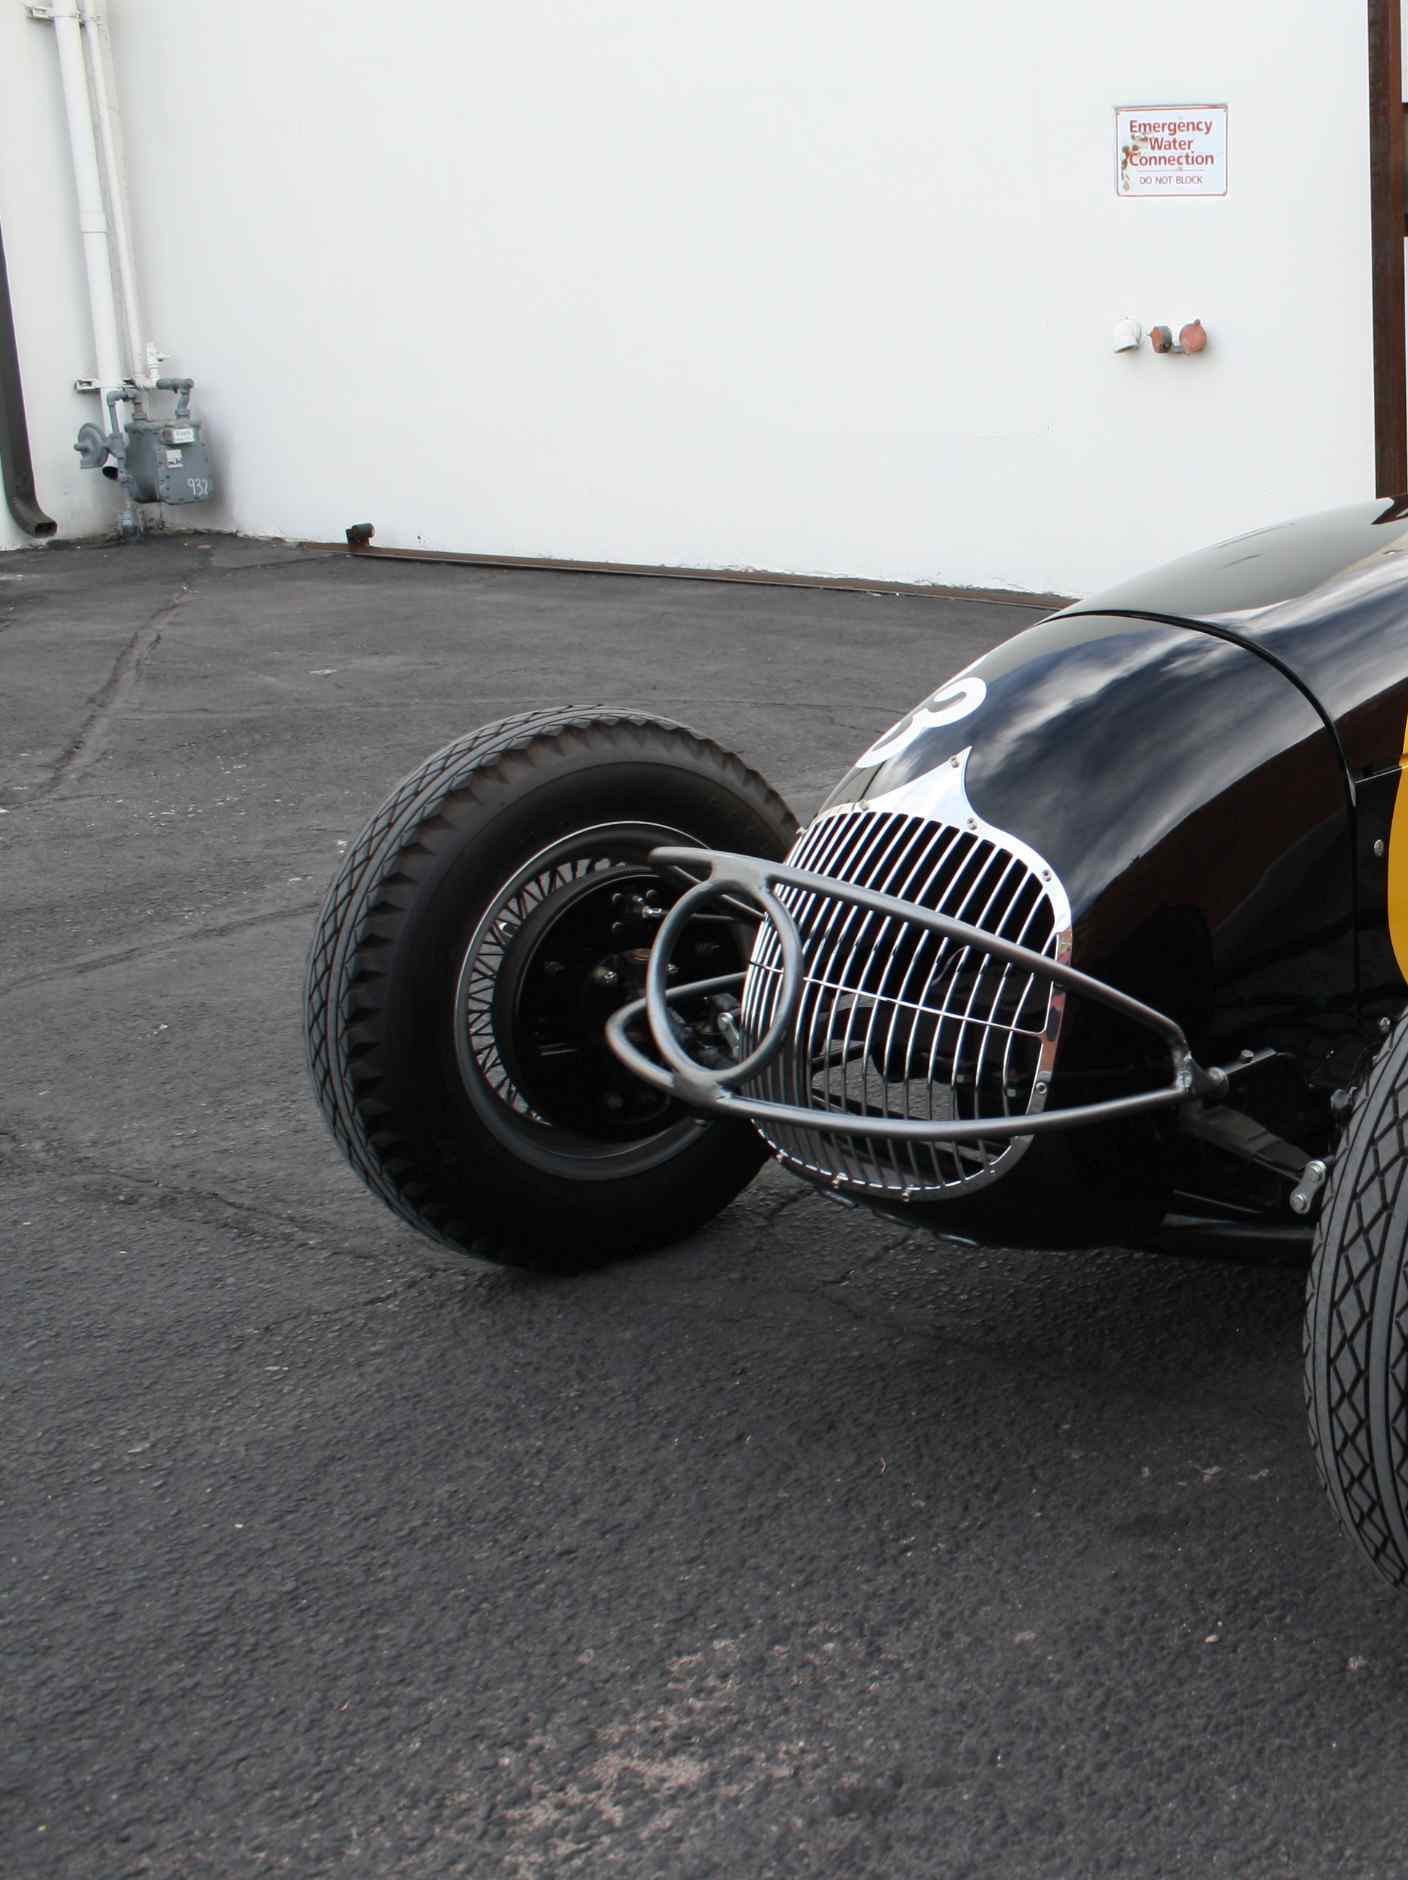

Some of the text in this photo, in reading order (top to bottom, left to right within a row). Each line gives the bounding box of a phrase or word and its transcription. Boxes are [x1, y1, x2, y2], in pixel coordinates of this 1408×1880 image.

[1129, 120, 1213, 135] Emergency
[1149, 137, 1194, 150] Water
[1129, 151, 1215, 166] Connection
[1139, 175, 1203, 184] DO NOT BLOCK
